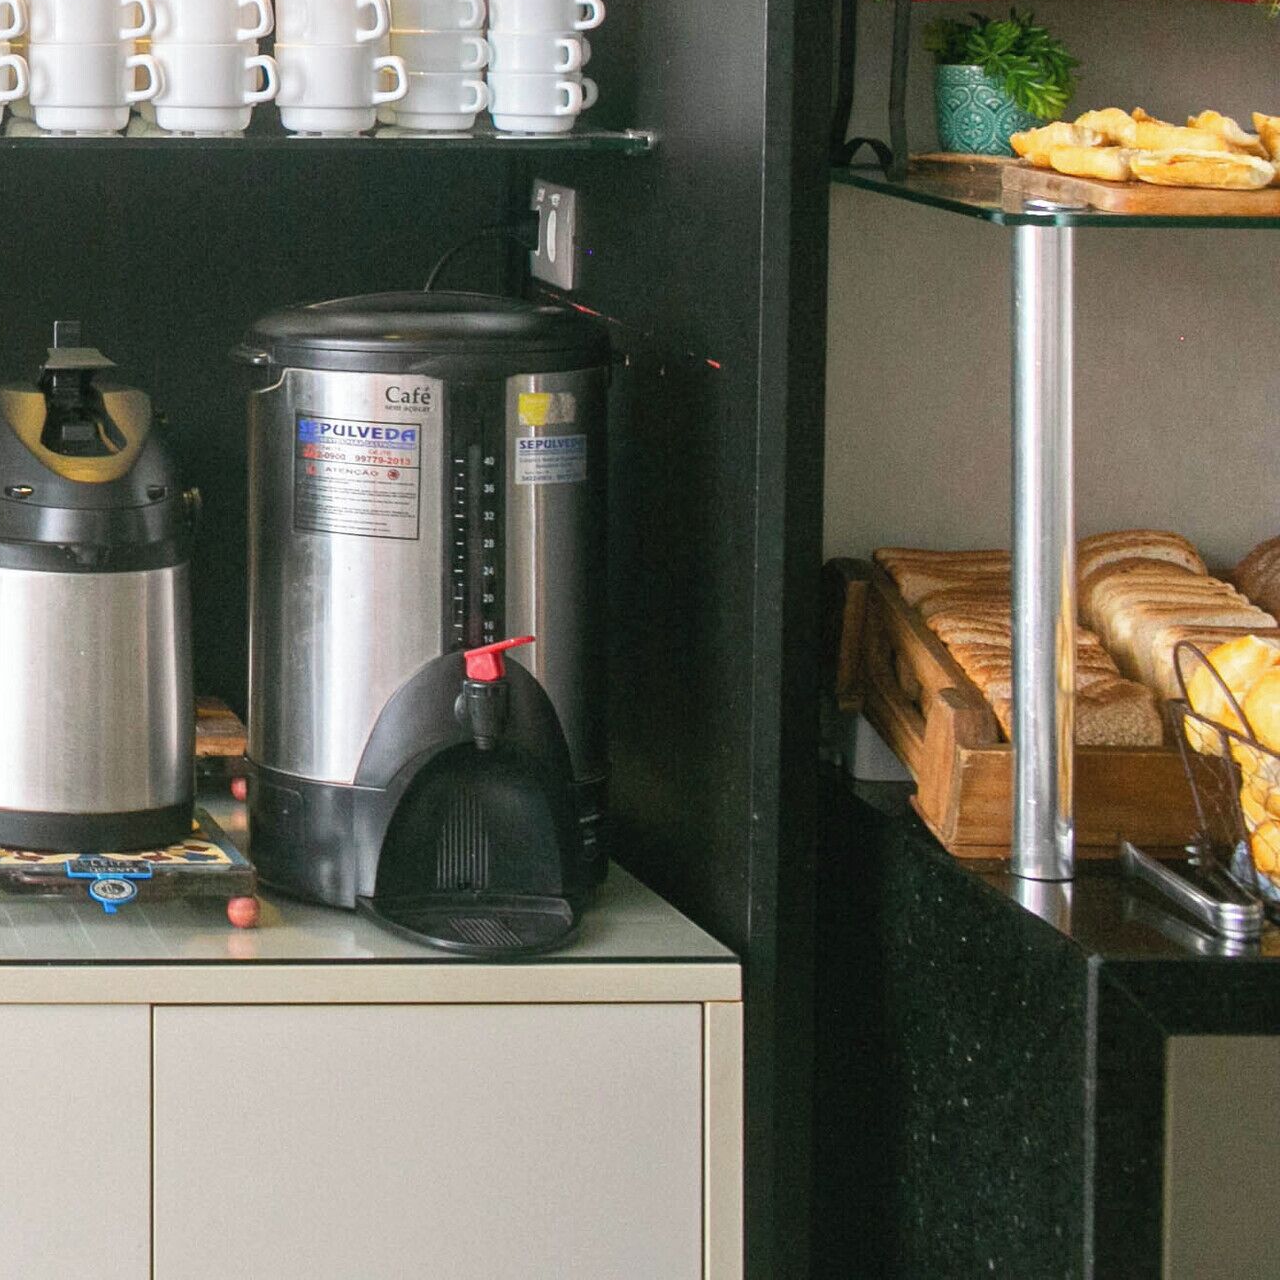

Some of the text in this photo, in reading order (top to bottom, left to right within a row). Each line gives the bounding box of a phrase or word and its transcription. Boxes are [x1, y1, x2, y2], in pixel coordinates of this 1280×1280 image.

[385, 384, 431, 405] Café
[298, 419, 417, 442] SEPULVEDA
[483, 456, 495, 466] 40
[483, 511, 495, 521] 32
[483, 538, 495, 549] 28
[482, 566, 495, 576] 24
[482, 593, 495, 603] 20
